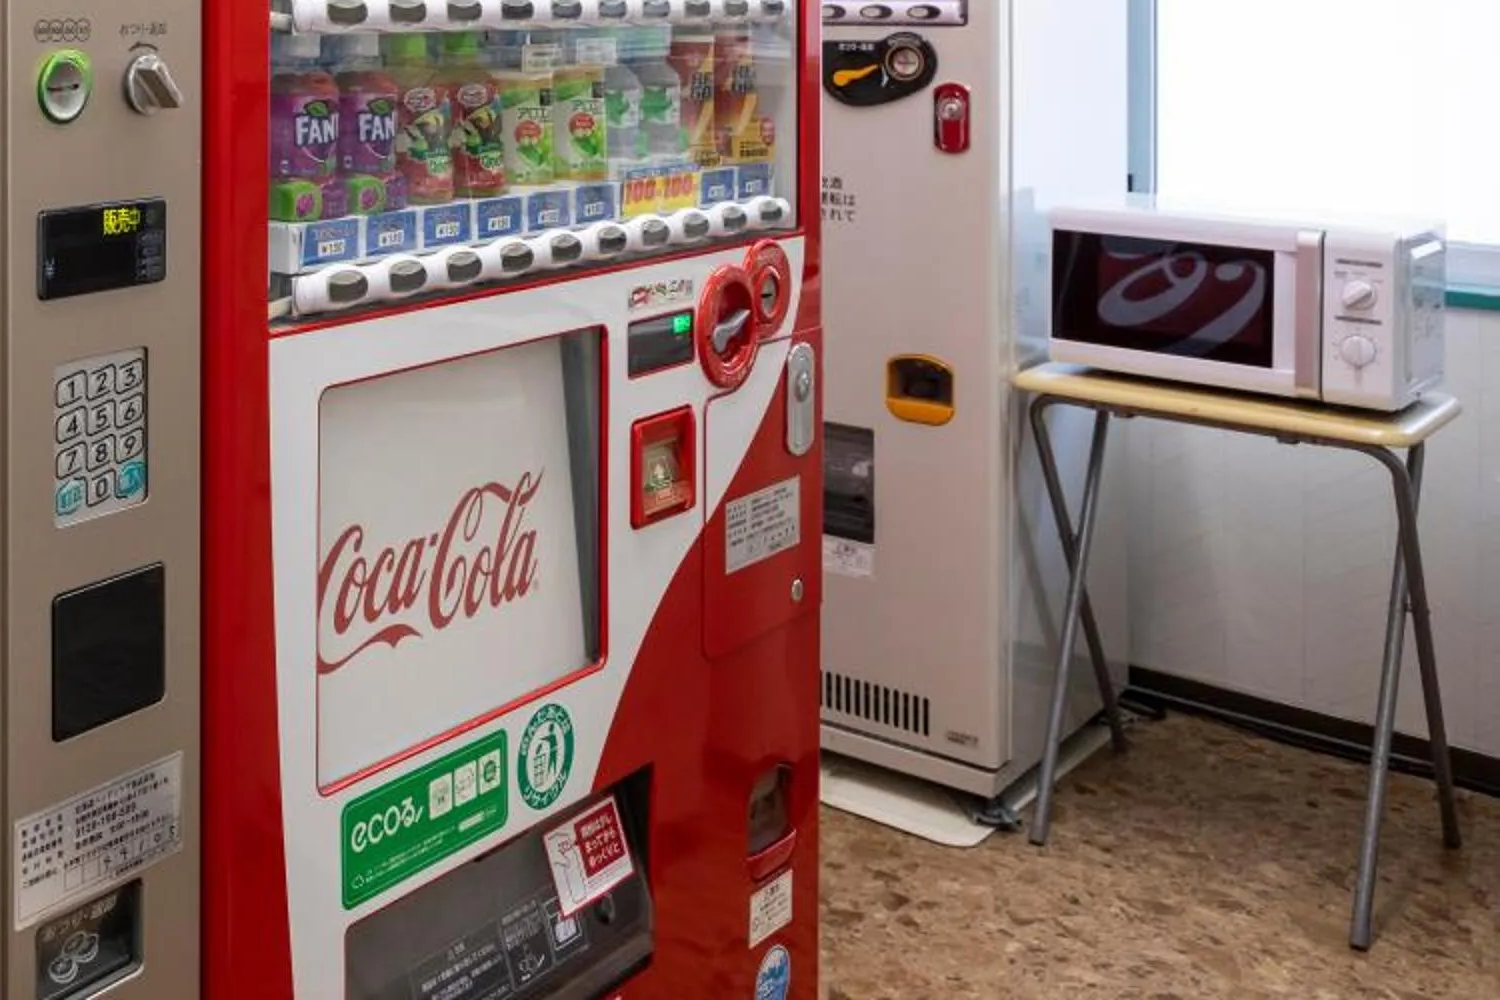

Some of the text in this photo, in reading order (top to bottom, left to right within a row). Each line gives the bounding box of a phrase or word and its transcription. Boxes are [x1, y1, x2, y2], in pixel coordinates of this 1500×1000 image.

[67, 367, 137, 399] 1 2 3
[67, 402, 136, 434] 4 5 6
[66, 435, 136, 471] 7 8 9
[95, 477, 108, 498] 0
[317, 465, 545, 674] Coca-Cola
